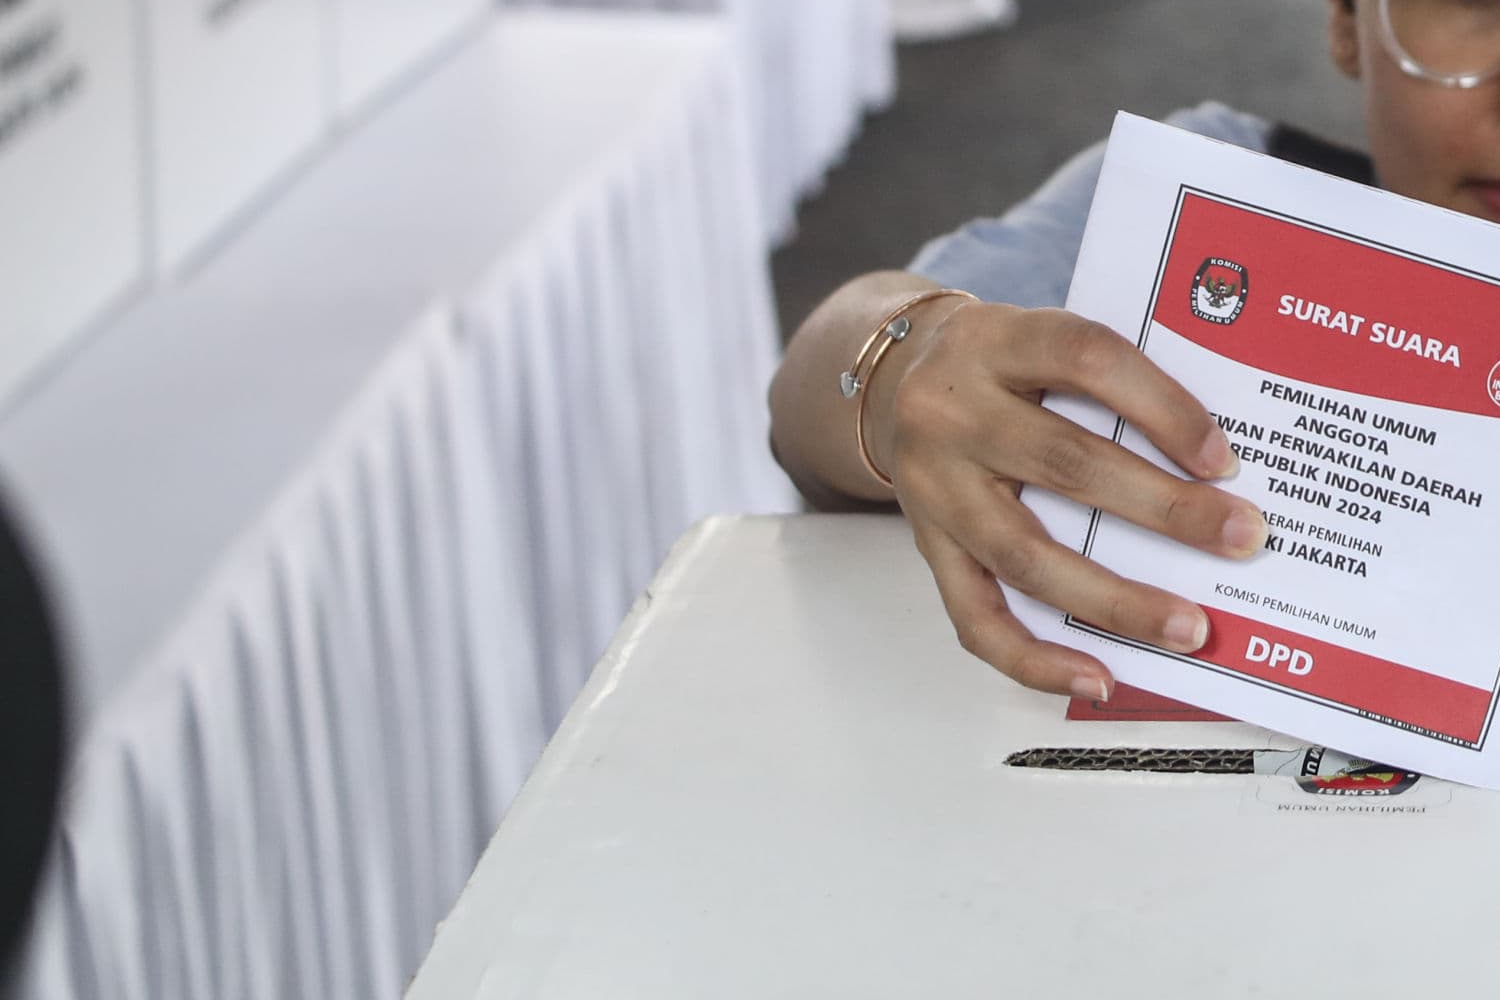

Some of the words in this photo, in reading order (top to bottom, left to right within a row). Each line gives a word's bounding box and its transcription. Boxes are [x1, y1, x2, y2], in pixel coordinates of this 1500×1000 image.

[1210, 258, 1243, 273] KOMISI
[1191, 288, 1222, 324] PEMILIHAN
[1223, 301, 1244, 324] UMUM
[1277, 294, 1365, 336] SURAT
[1369, 322, 1461, 368] SUARA
[1259, 379, 1367, 424] PEMILIHAN
[1372, 413, 1437, 446] UMUM
[1293, 415, 1389, 456] ANGGOTA
[1209, 411, 1265, 441] WAN
[1268, 430, 1396, 481] PERWAKILAN
[1400, 471, 1483, 508] DAERAH
[1230, 442, 1320, 482] REPUBLIK
[1324, 471, 1431, 517] INDONESIA
[1267, 477, 1332, 509] TAHUN
[1336, 498, 1382, 525] 2024
[1261, 510, 1305, 534] AERAH
[1307, 524, 1383, 557] PEMILIHAN
[1264, 534, 1285, 553] KI
[1287, 541, 1368, 578] JAKARTA
[1214, 582, 1261, 605] KOMISI
[1262, 596, 1332, 626] PEMILIHAN
[1333, 618, 1377, 640] UMUM
[1244, 635, 1315, 676] DPD
[1317, 787, 1390, 796] KOMISI
